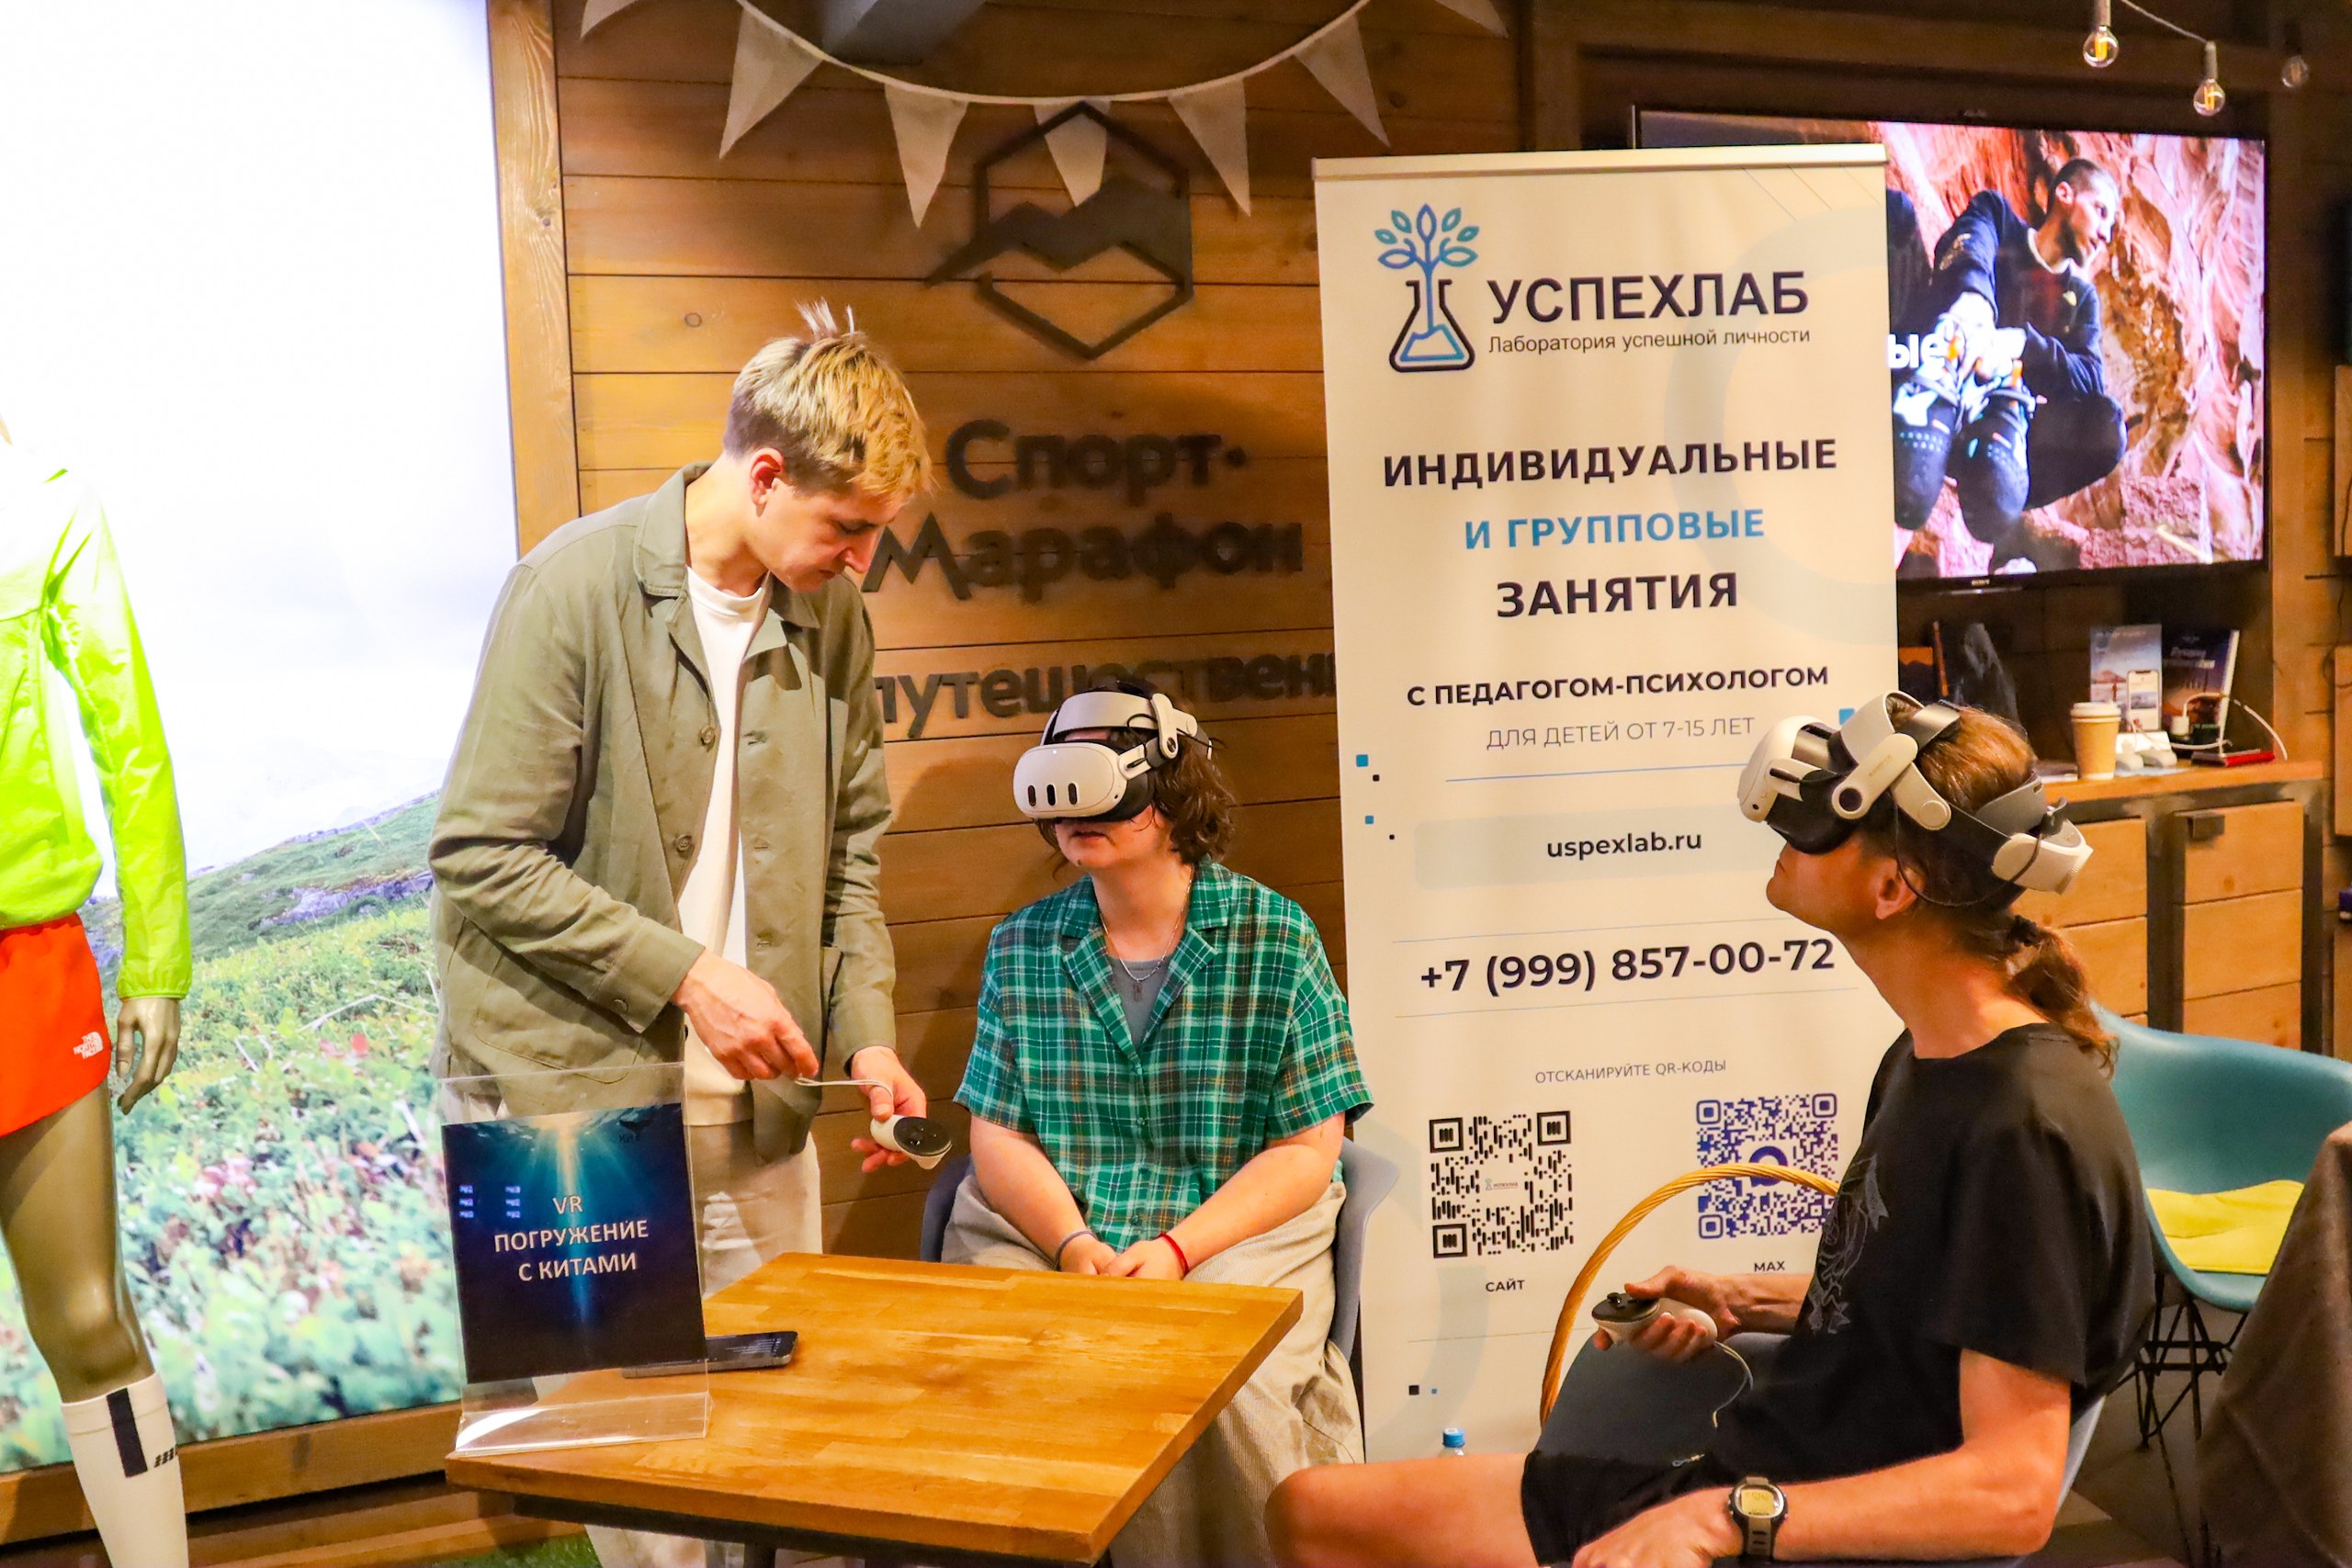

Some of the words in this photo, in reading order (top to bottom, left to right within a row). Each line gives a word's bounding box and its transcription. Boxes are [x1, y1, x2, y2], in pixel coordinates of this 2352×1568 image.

[1487, 271, 1808, 324] УСПЕХЛАБ
[1488, 334, 1616, 355] Лаборатория
[1622, 333, 1717, 353] успешной
[1723, 329, 1812, 347] личности
[1384, 439, 1837, 491] ИНДИВИДУАЛЬНЫЕ
[1465, 521, 1490, 550] И
[1508, 509, 1764, 548] ГРУППОВЫЕ
[861, 512, 1303, 604] Марафон
[1497, 572, 1736, 618] ЗАНЯТИЯ
[1407, 686, 1426, 706] С
[1435, 666, 1827, 706] ПЕДАГОГОМ-ПСИХОЛОГОМ
[1486, 728, 1536, 750] ДЛЯ
[1543, 724, 1619, 749] ДЕТЕЙ
[1626, 721, 1657, 740] ОТ
[1663, 719, 1705, 739] 7-15
[1711, 716, 1755, 736] ЛЕТ
[1547, 831, 1702, 861] uspexlab.ru
[1420, 959, 1470, 992] +7
[1487, 950, 1595, 998] (999)
[1610, 937, 1836, 983] 857-00-72
[1534, 1064, 1651, 1084] ОТСКАНИРУЙТЕ
[1655, 1059, 1726, 1077] QR-КОДЫ
[551, 1194, 584, 1216] VR
[492, 1218, 650, 1254] ПОГРУЖЕНИЕ
[518, 1262, 533, 1281] С
[538, 1252, 637, 1280] КИТАМИ
[1754, 1260, 1785, 1272] MAX
[1485, 1280, 1525, 1292] САЙТ
